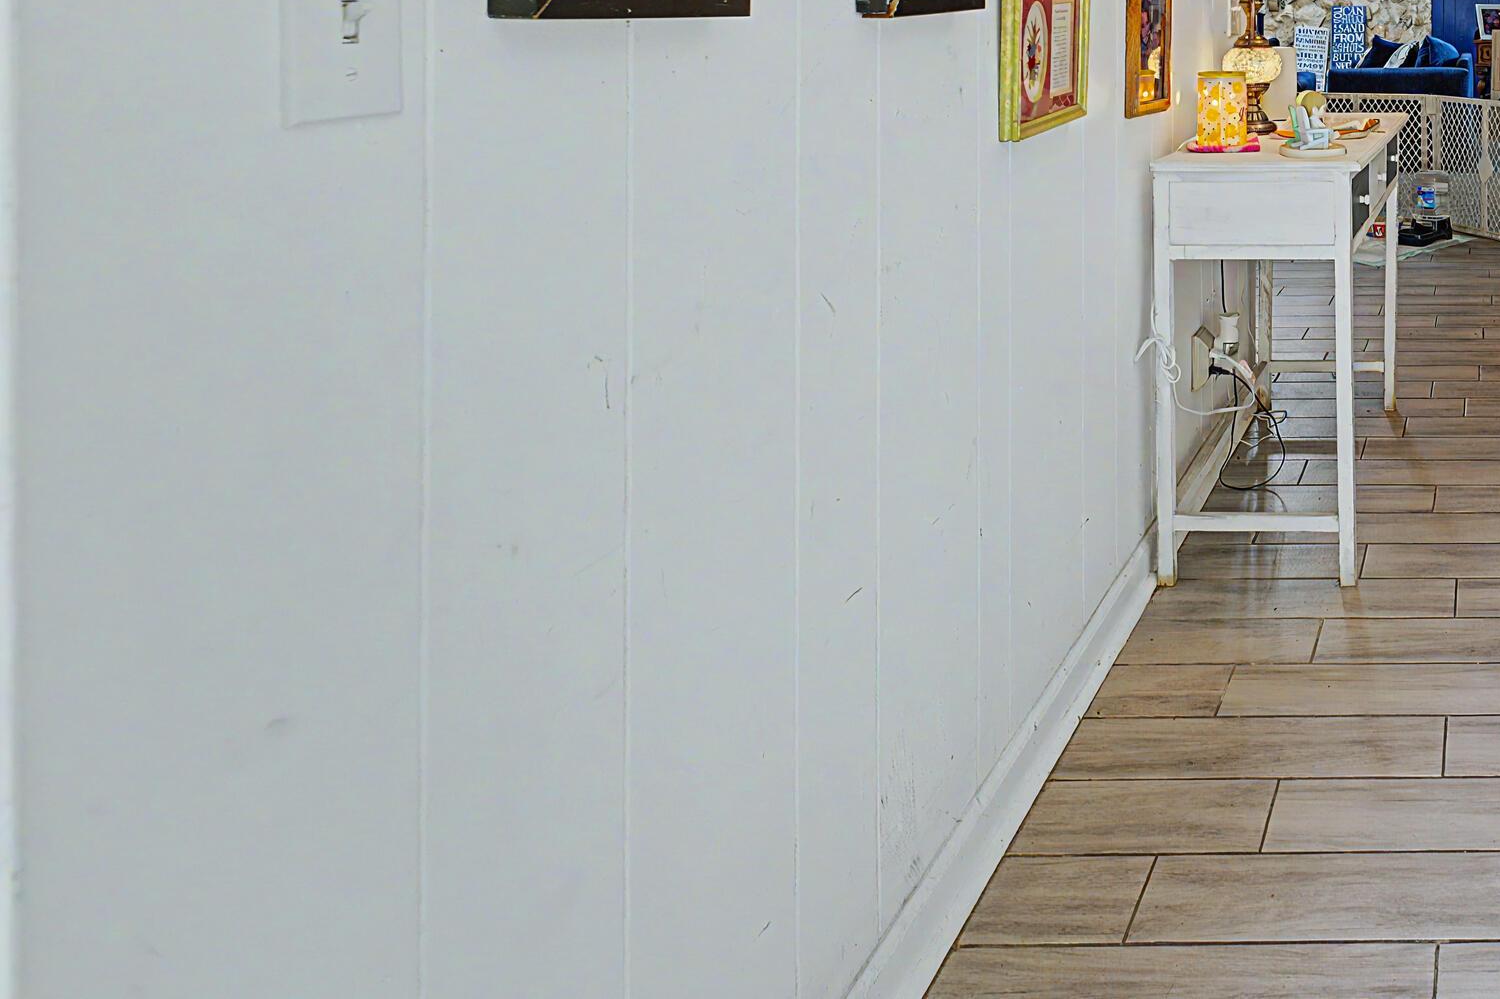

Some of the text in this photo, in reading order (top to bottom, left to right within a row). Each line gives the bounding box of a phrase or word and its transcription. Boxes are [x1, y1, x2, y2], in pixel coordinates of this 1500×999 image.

[1343, 6, 1364, 16] CAN
[1340, 24, 1365, 33] SAND
[1333, 33, 1364, 44] FROM
[1333, 53, 1353, 63] BUT
